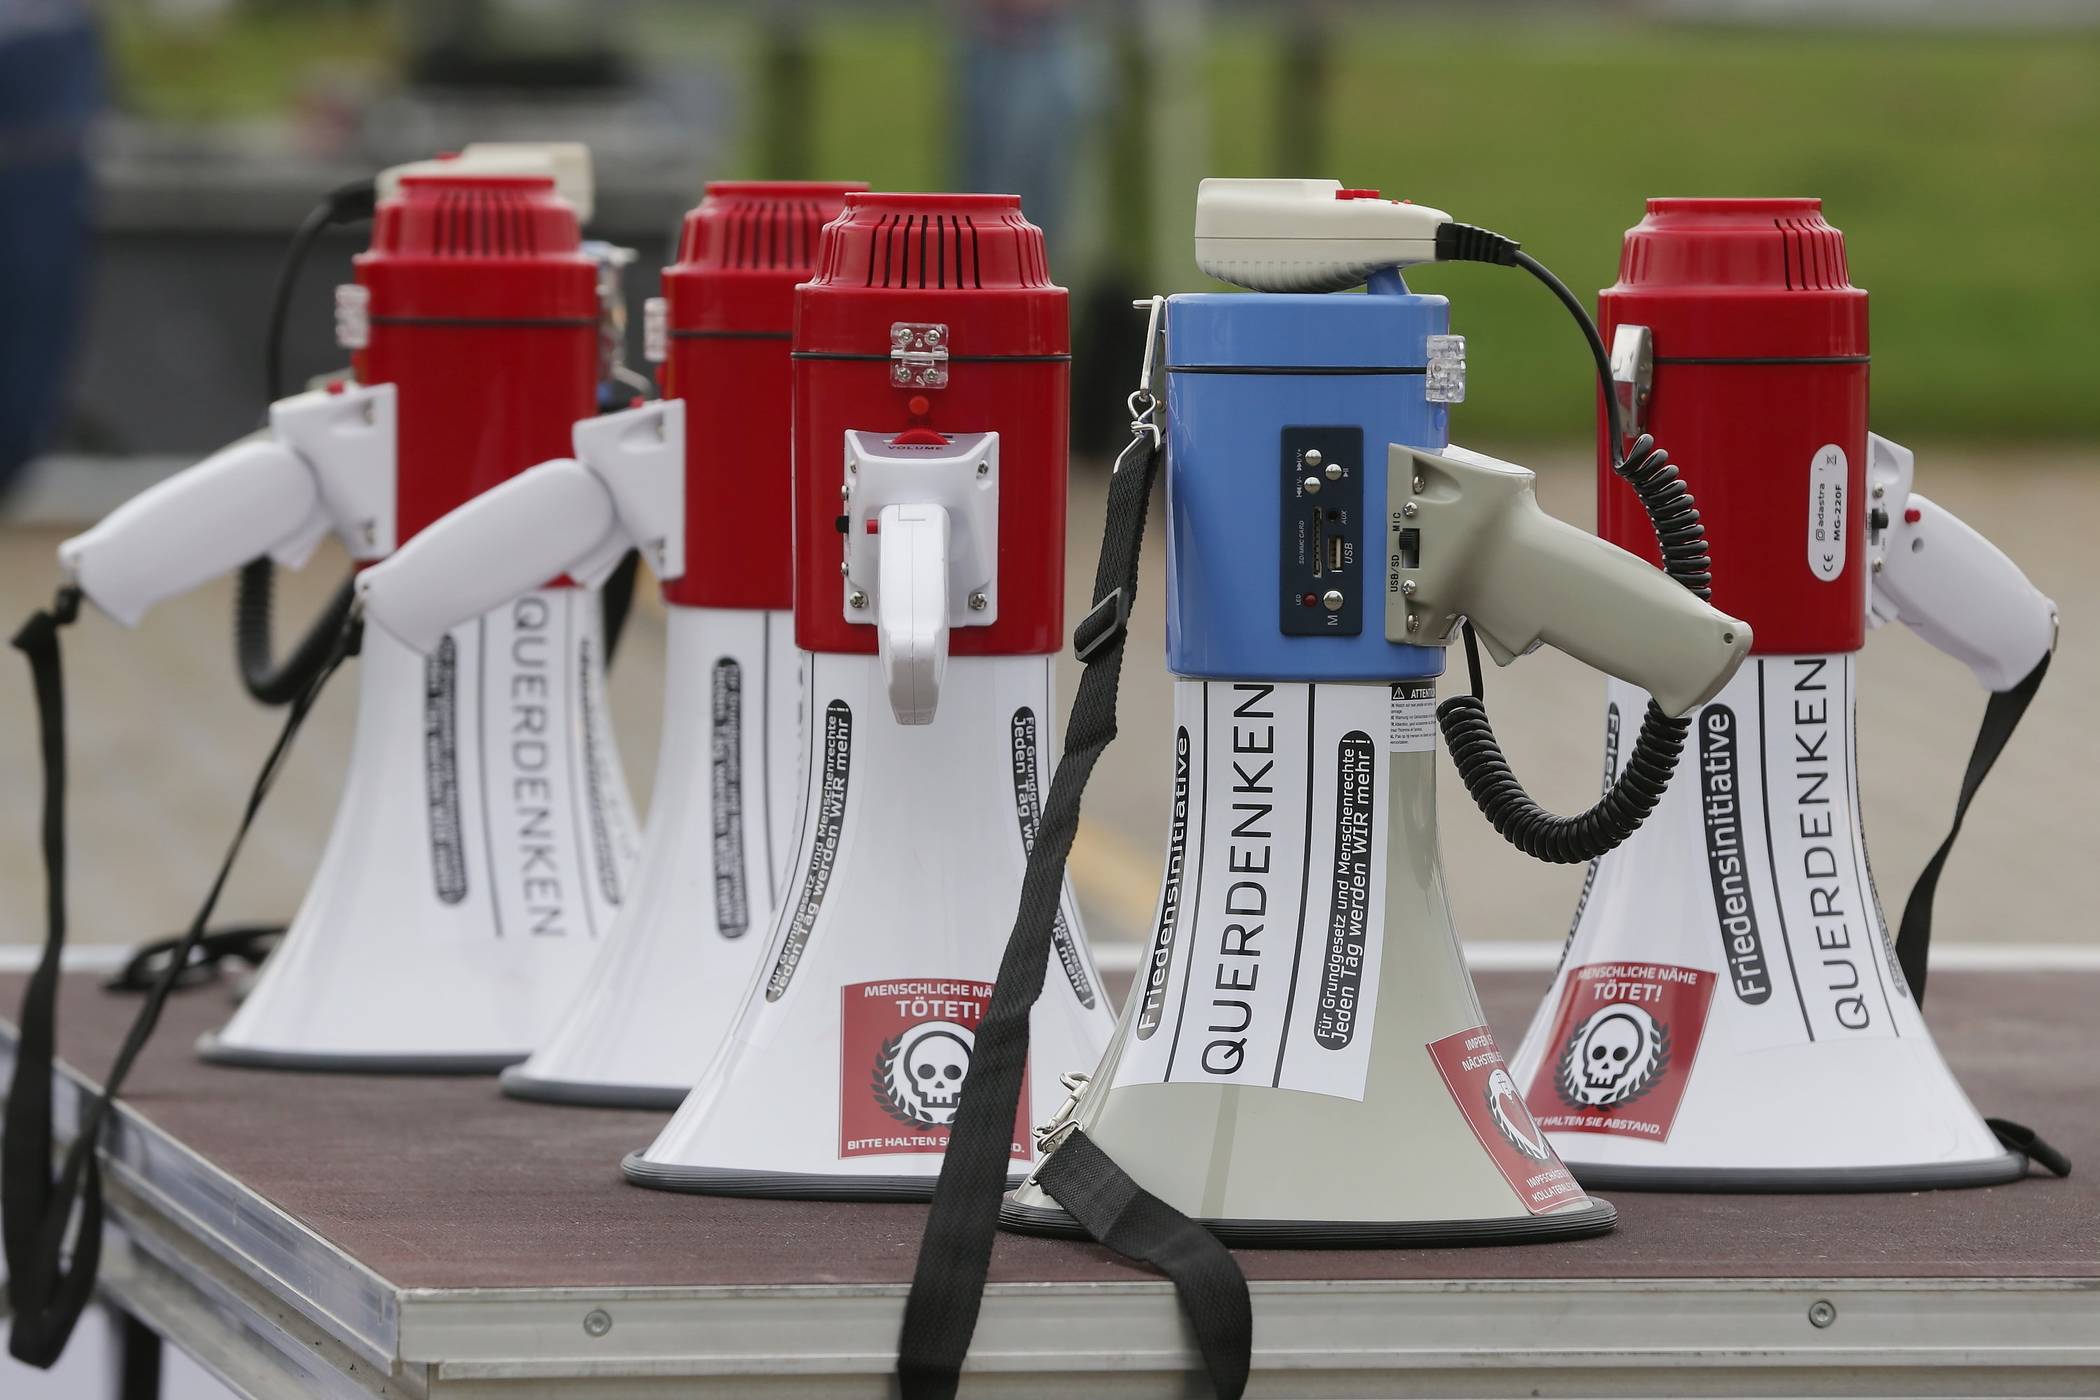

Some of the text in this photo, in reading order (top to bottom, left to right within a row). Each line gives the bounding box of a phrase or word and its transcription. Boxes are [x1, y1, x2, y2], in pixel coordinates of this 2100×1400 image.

[1340, 510, 1348, 525] AUX
[1392, 511, 1401, 531] MIC
[1818, 483, 1826, 527] adastra
[1833, 484, 1842, 541] MG-220F
[1344, 542, 1354, 564] USB
[1390, 554, 1400, 592] USB/SD
[1328, 615, 1338, 626] M
[836, 718, 849, 771] mehr
[1013, 716, 1026, 773] Jeden
[1025, 716, 1036, 741] Für
[512, 596, 569, 938] QUERDENKEN
[817, 715, 837, 838] Menschenrechte
[1355, 750, 1371, 805] mehr
[829, 777, 846, 817] WIR
[1017, 779, 1031, 818] Tag
[1026, 745, 1041, 838] Grundgeset
[1337, 748, 1354, 875] Menschenrechte
[1352, 812, 1369, 854] WIR
[1794, 658, 1870, 1031] QUERDENKEN
[811, 841, 824, 870] und
[812, 825, 839, 896] werden
[1703, 712, 1767, 998] Friedensinitiative
[1138, 737, 1188, 1030] Friedensinitiative
[1201, 684, 1275, 1076] QUERDENKEN
[1336, 879, 1349, 910] und
[1348, 862, 1367, 936] werden
[779, 874, 816, 965] Grundgesetz
[798, 902, 820, 935] Tag
[773, 943, 803, 997] Jeden
[1059, 946, 1085, 993] mehr
[1322, 914, 1347, 1009] Grundgesetz
[1340, 943, 1363, 978] Tag
[1578, 965, 1698, 985] MENSCHLICHE NÄHE
[864, 983, 993, 998] MENSCHLICHE NÄ
[895, 996, 981, 1019] TÖTET!
[1593, 979, 1664, 1002] TÖTET!
[1317, 1012, 1333, 1038] Für
[1330, 986, 1355, 1044] Jeden
[847, 1138, 882, 1150] BITTE
[884, 1136, 937, 1148] HALTEN
[1543, 1115, 1584, 1127] HALTEN
[1585, 1116, 1603, 1127] SIE
[1603, 1117, 1662, 1135] ABSTAND.
